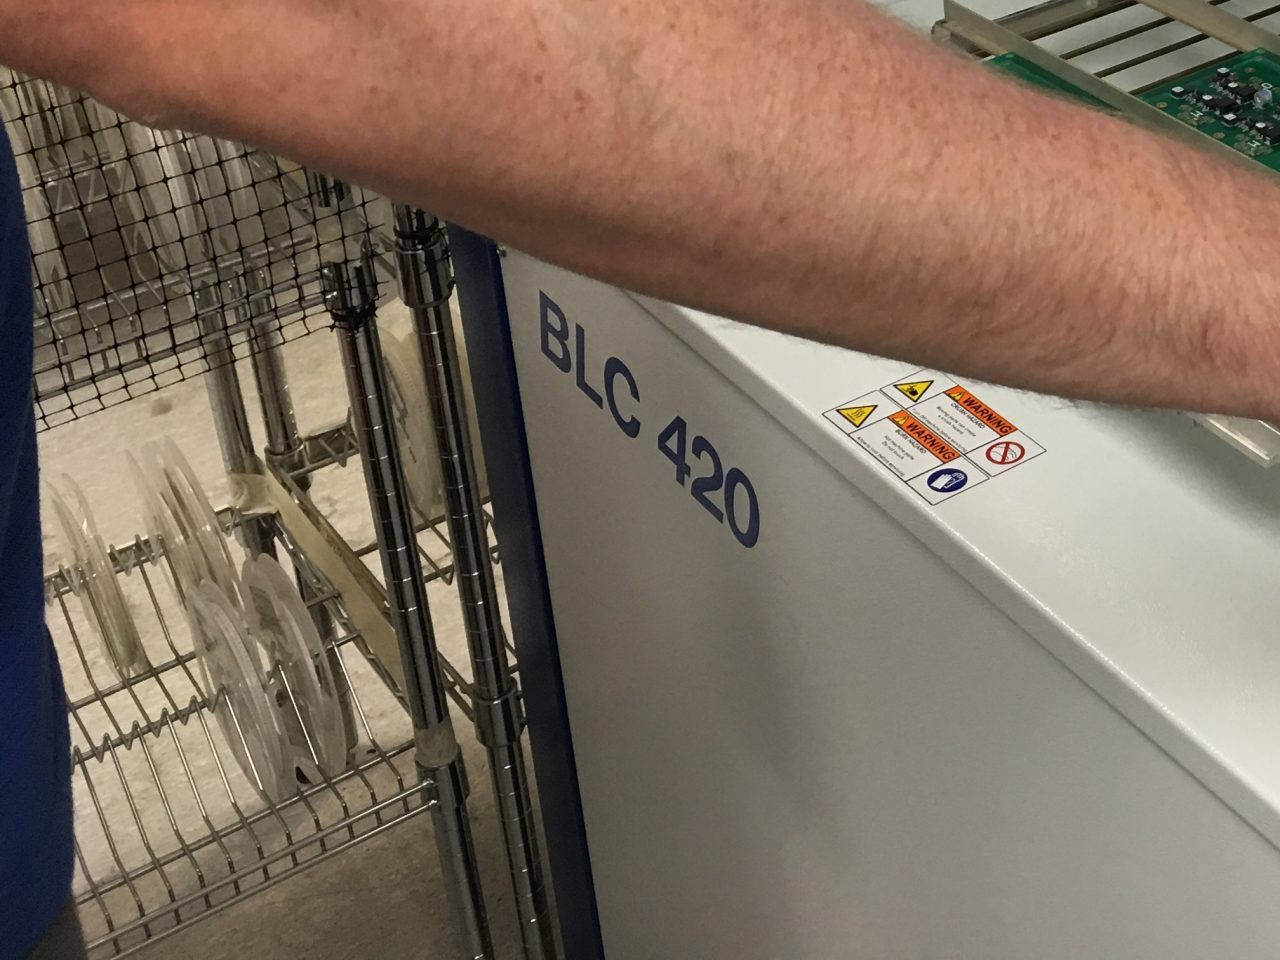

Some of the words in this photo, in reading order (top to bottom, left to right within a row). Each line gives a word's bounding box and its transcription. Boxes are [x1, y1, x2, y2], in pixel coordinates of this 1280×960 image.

[539, 289, 641, 439] BLC
[657, 415, 760, 548] 420
[963, 397, 1014, 434] WARNING
[906, 422, 957, 460] WARNING
